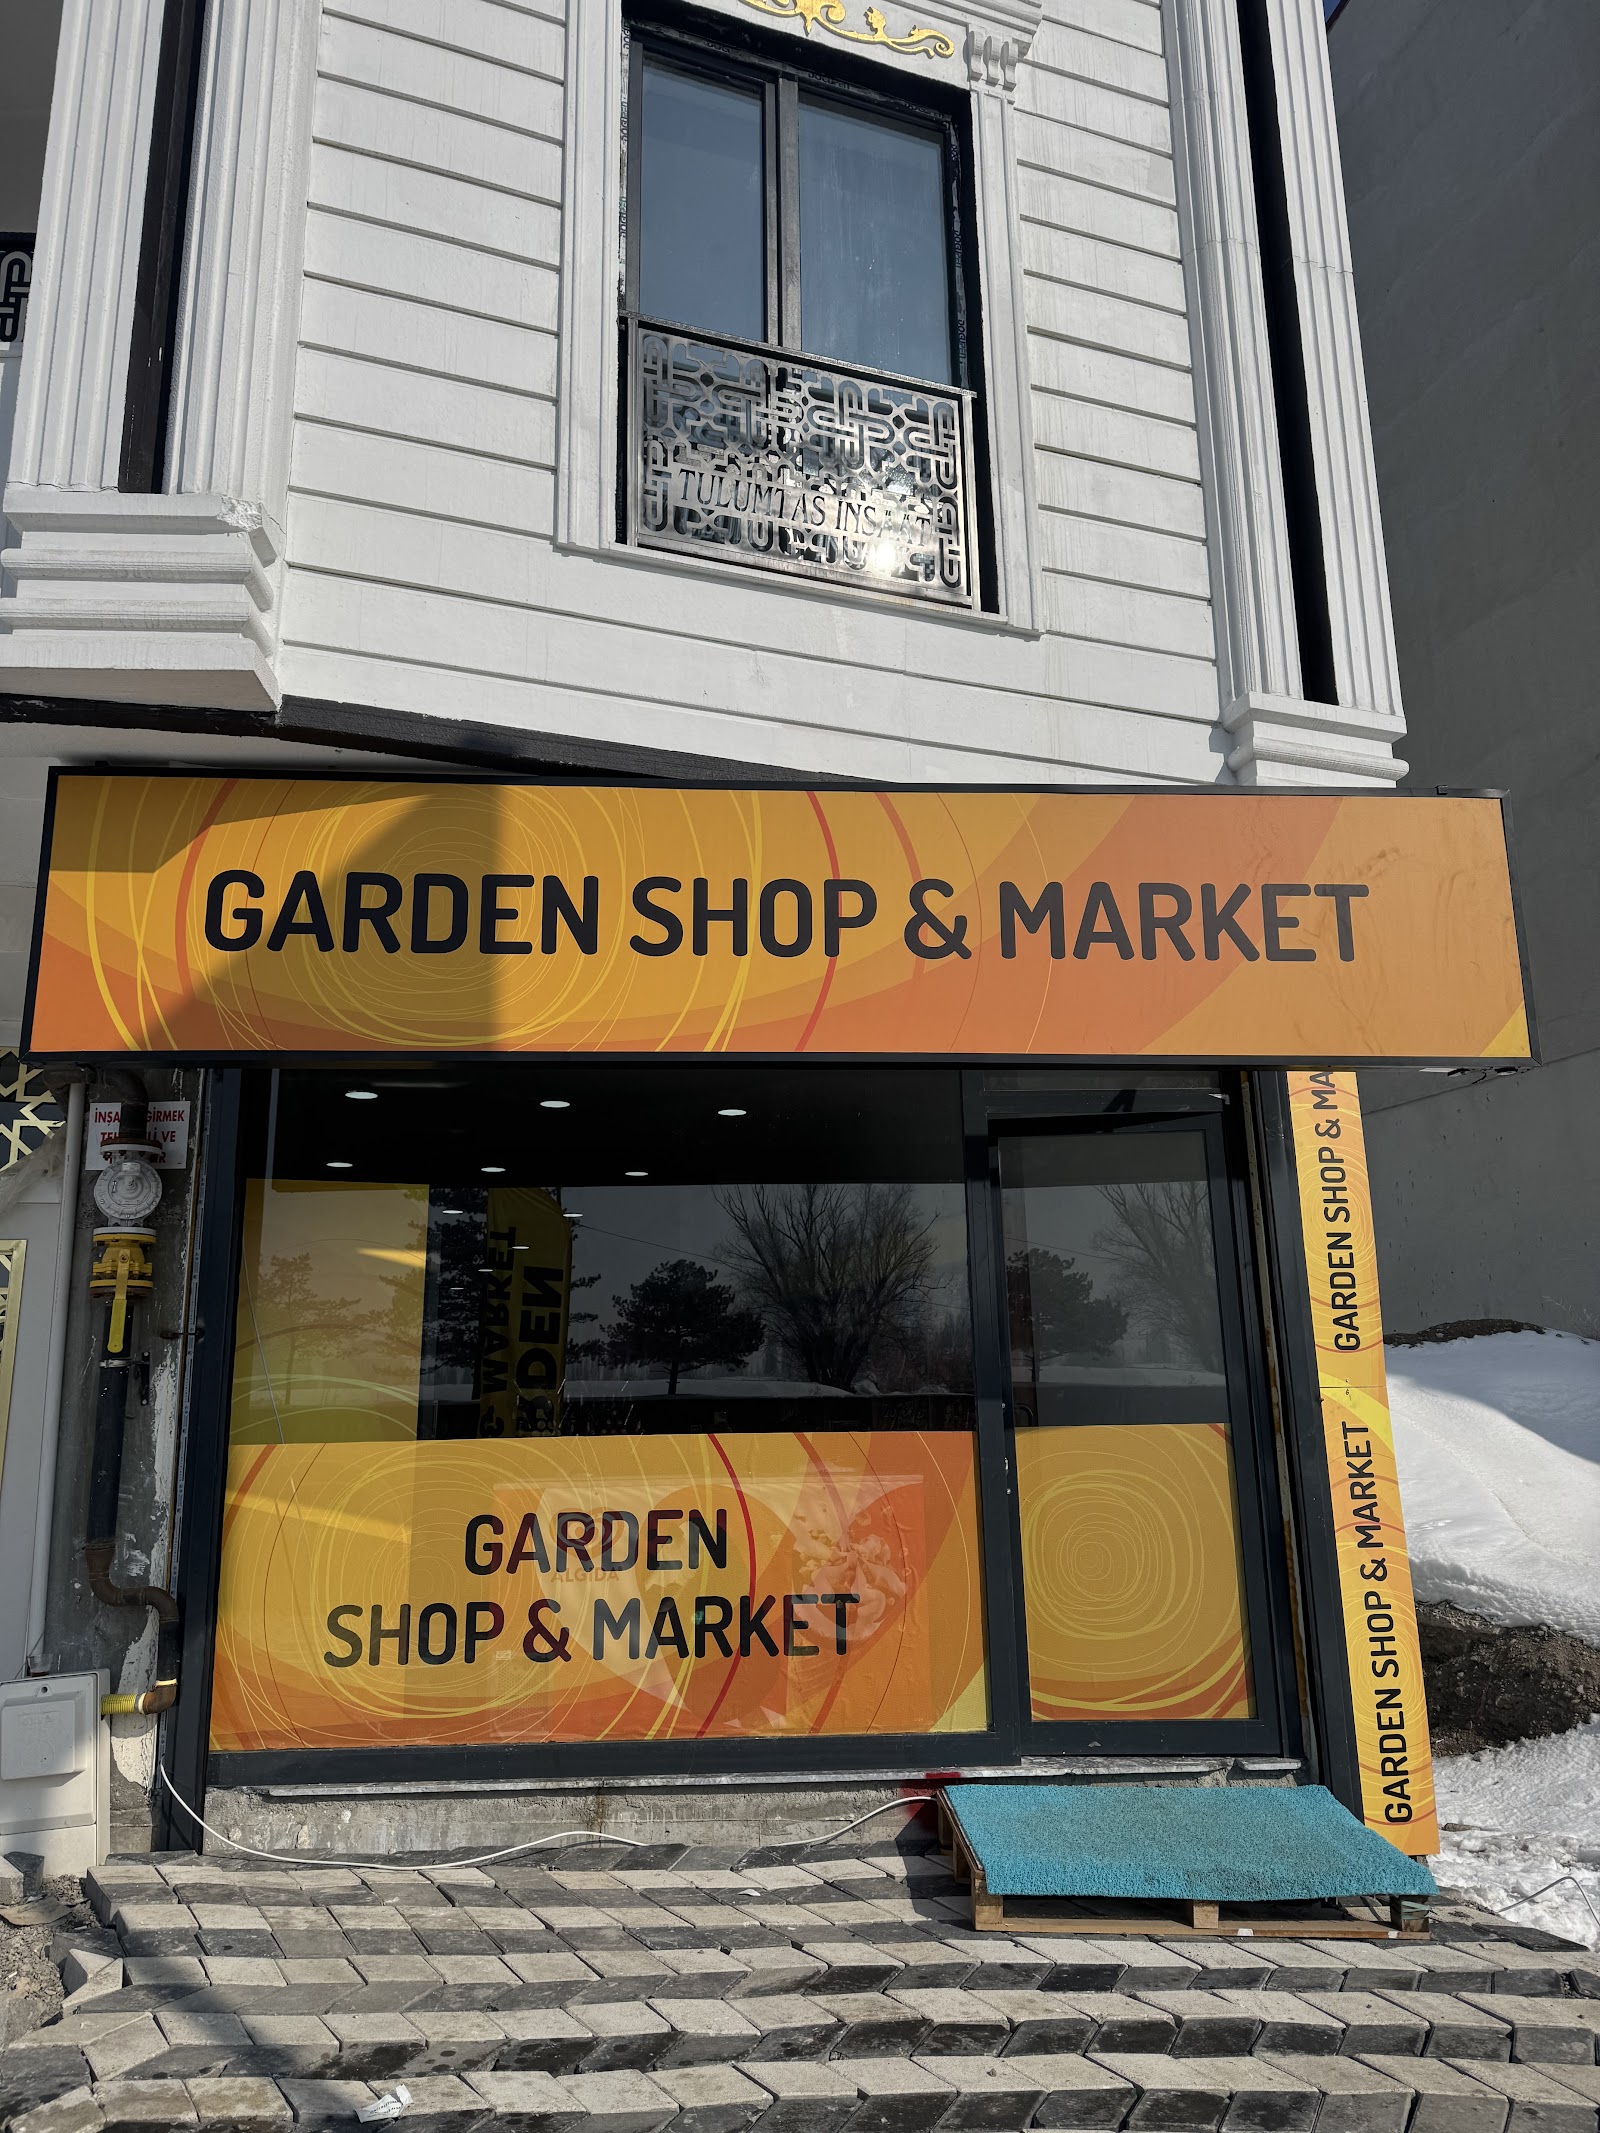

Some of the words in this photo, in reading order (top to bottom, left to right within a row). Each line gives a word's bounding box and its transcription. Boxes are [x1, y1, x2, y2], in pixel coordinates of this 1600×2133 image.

[204, 869, 599, 955] GARDEN
[630, 876, 878, 957] SHOP
[904, 878, 972, 960] &
[999, 881, 1369, 962] MARKET
[162, 1130, 176, 1142] VE
[1315, 1118, 1341, 1139] &
[1318, 1146, 1352, 1223] SHOP
[1326, 1232, 1361, 1351] GARDEN
[1342, 1421, 1384, 1548] MARKET
[464, 1508, 728, 1575] GARDEN
[1360, 1557, 1388, 1581] &
[323, 1601, 505, 1667] SHOP
[522, 1598, 572, 1663] &
[592, 1593, 861, 1661] MARKET
[1364, 1591, 1399, 1677] SHOP
[1375, 1688, 1413, 1823] GARDEN
